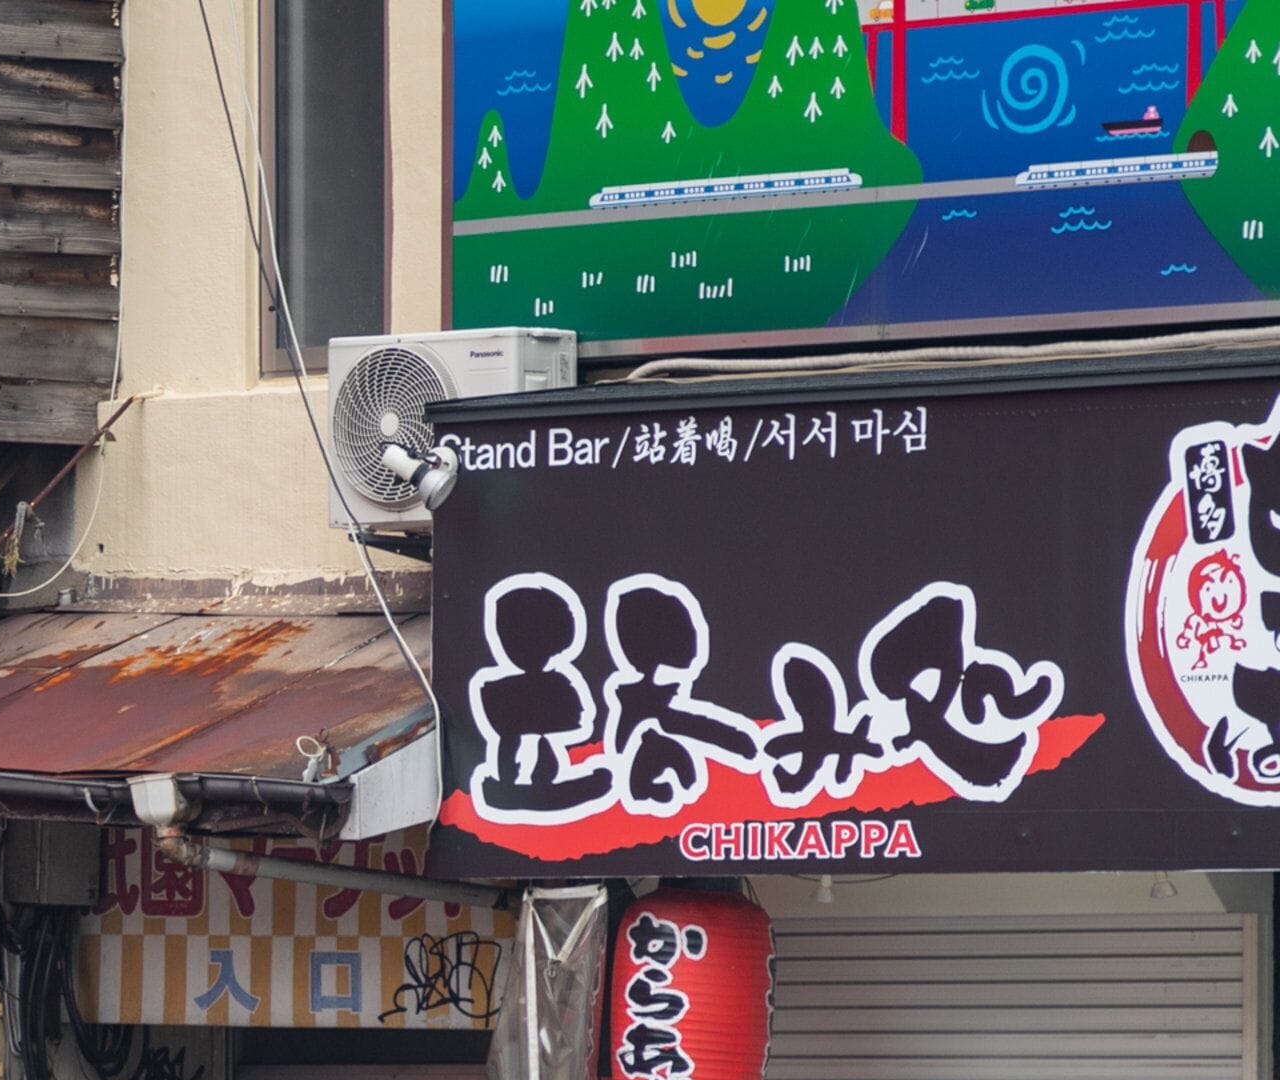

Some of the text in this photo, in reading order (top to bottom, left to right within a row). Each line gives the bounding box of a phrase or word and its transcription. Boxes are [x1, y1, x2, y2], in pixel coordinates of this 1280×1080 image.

[470, 350, 504, 358] Panasonic
[851, 406, 927, 455] 마심
[1189, 442, 1226, 540] 博多
[1181, 673, 1229, 684] CHIKAPPA
[679, 820, 922, 861] CHIKAPPA
[194, 949, 363, 1013] 入口
